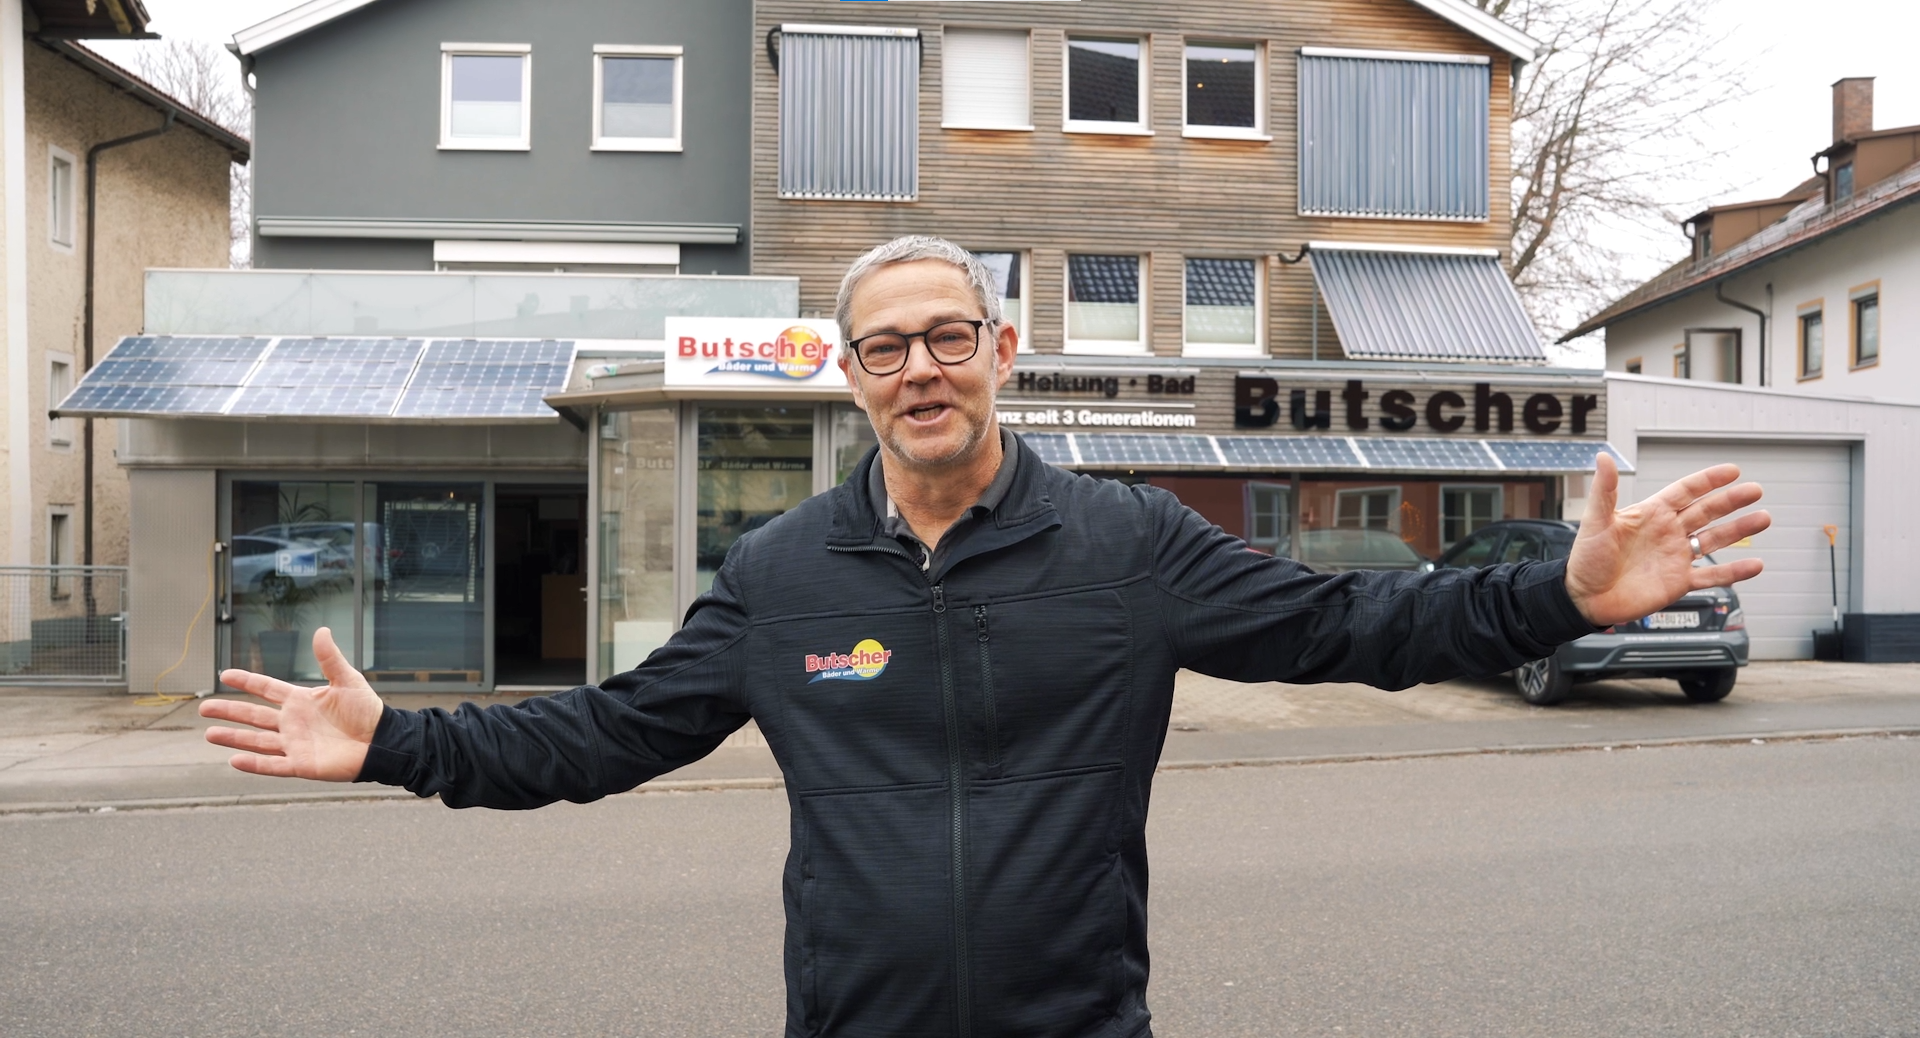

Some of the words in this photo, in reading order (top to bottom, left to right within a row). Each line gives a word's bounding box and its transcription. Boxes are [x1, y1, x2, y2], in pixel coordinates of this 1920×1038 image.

[678, 335, 833, 358] Butscher
[754, 362, 775, 371] und
[1147, 374, 1196, 394] Bad
[1235, 375, 1597, 434] Butscher
[1025, 408, 1059, 425] seit
[1062, 410, 1075, 425] 3
[1077, 410, 1196, 427] Generationen
[805, 649, 892, 672] Butscher
